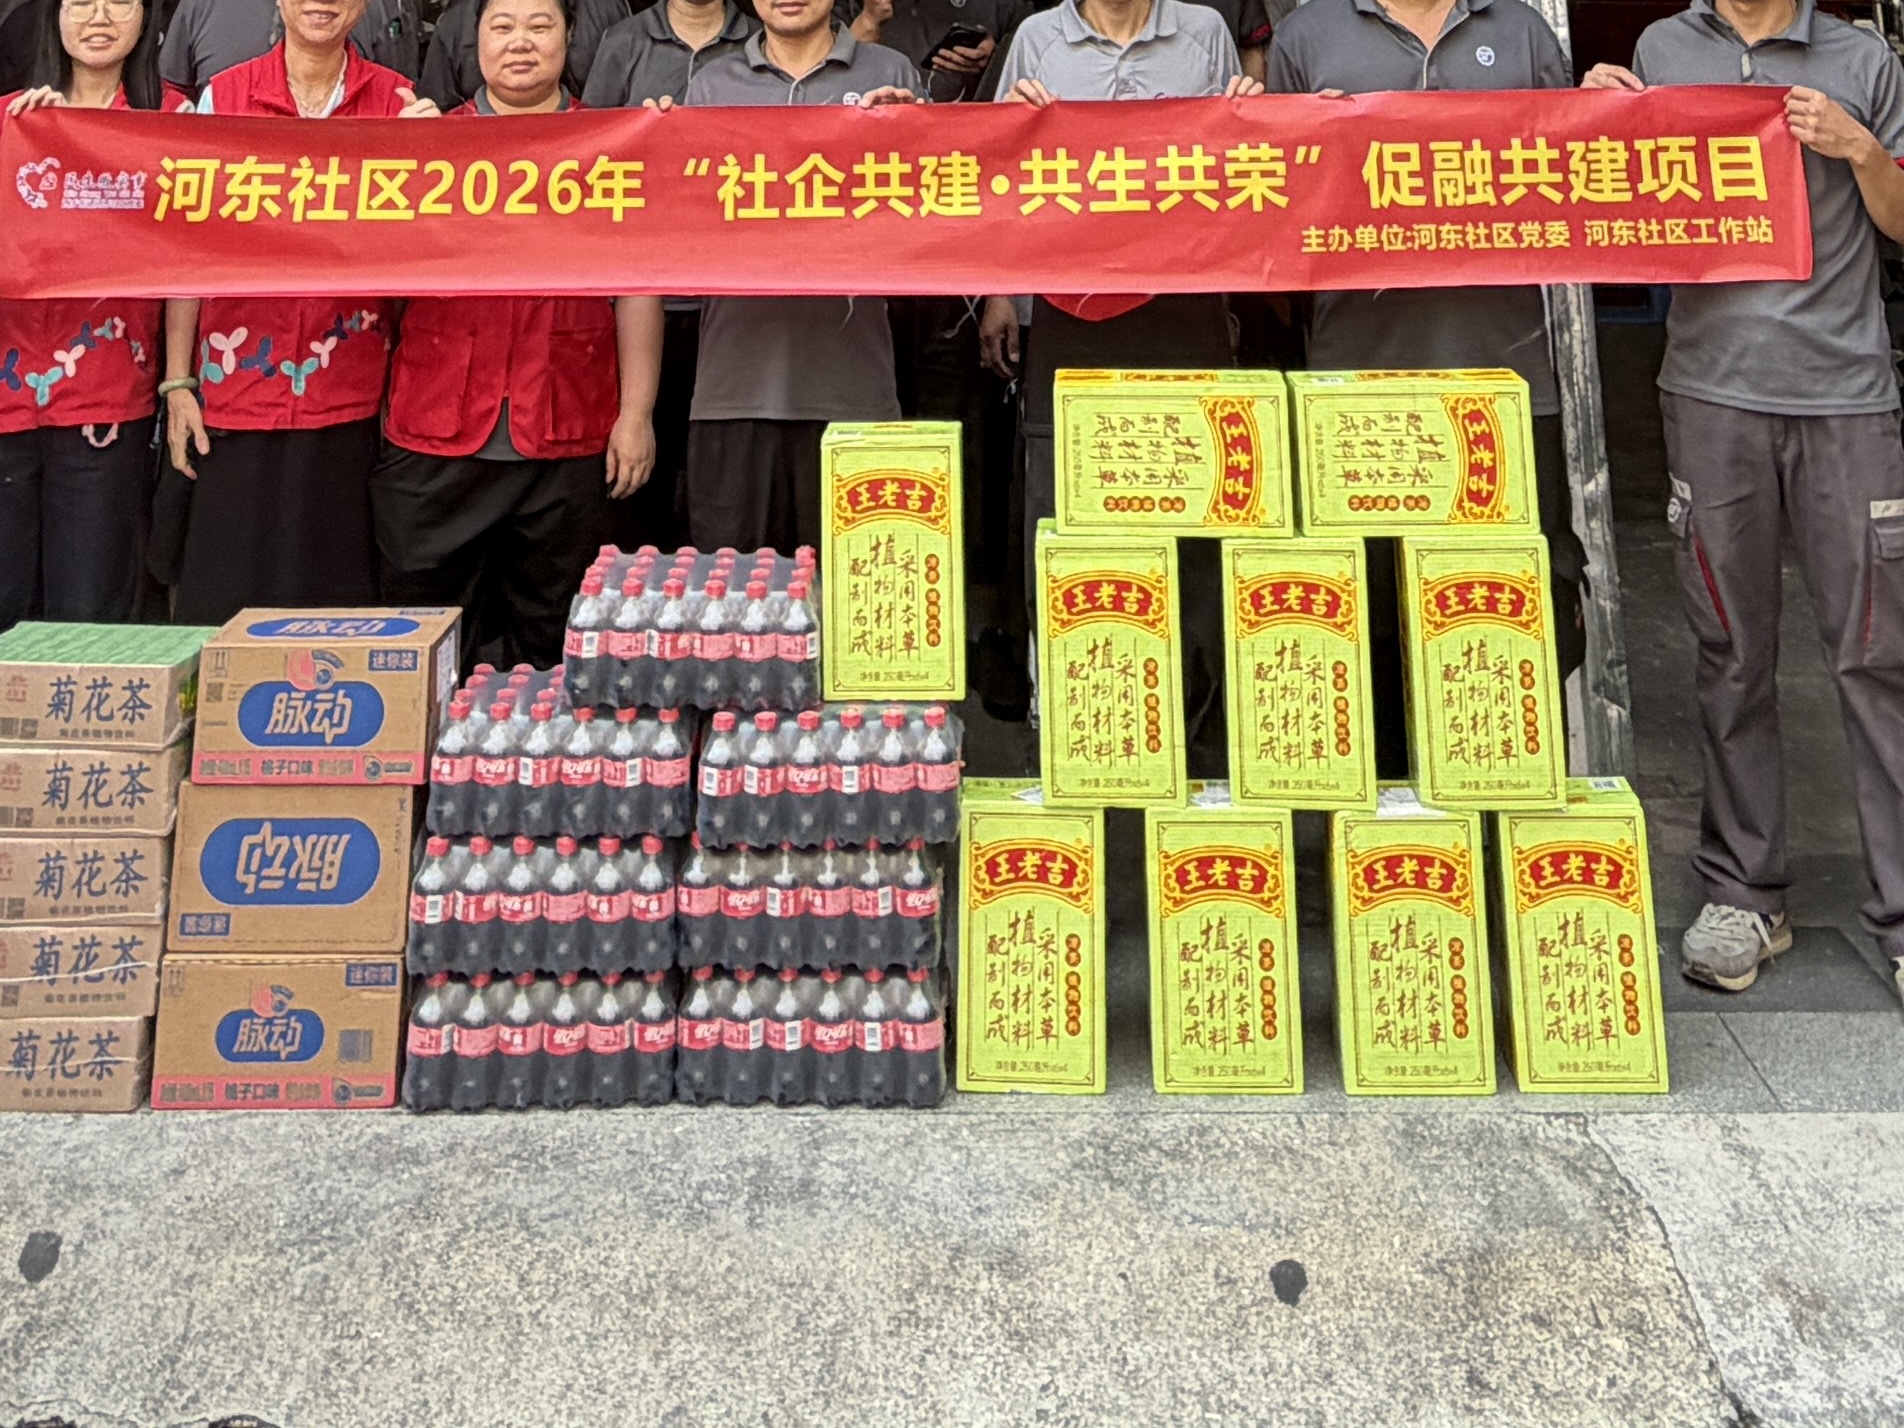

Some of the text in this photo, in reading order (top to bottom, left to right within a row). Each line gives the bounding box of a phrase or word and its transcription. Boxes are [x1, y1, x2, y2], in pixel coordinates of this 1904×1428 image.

[152, 154, 646, 223] 河东社区2026年
[1362, 135, 1770, 211] 促融共建项目
[1583, 217, 1774, 248] 河东社区工作站
[855, 481, 927, 511] 王老吉
[1222, 421, 1252, 500] 王老吉
[1464, 418, 1496, 498] 王老吉
[274, 619, 387, 635] 脉动
[870, 535, 897, 663] 植物材料
[897, 549, 919, 660] 采用本草
[1070, 584, 1144, 614] 王老吉
[1258, 584, 1332, 615] 王老吉
[1444, 583, 1517, 615] 王老吉
[45, 674, 153, 724] 菊花茶
[264, 689, 353, 744] 脉动
[1087, 636, 1115, 770] 植物材料
[1116, 653, 1139, 766] 采用本草
[1275, 639, 1303, 772] 植物材料
[1303, 654, 1328, 764] 采用本草
[1461, 639, 1493, 773] 植物材料
[1491, 654, 1518, 766] 采用本草
[41, 760, 154, 811] 菊花茶
[32, 849, 148, 900] 菊花茶
[235, 821, 351, 894] 脉动
[994, 851, 1069, 885] 王老吉
[1183, 858, 1260, 892] 王老吉
[1372, 856, 1448, 890] 王老吉
[1539, 852, 1615, 887] 王老吉
[30, 934, 146, 986] 菊花茶
[1008, 909, 1036, 1051] 植物材料
[1036, 928, 1059, 1043] 采用本草
[1200, 916, 1229, 1056] 植物材料
[1231, 933, 1255, 1047] 采用本草
[1390, 915, 1420, 1055] 植物材料
[1419, 932, 1446, 1046] 采用本草
[1559, 912, 1591, 1052] 植物材料
[1589, 928, 1618, 1044] 采用本草
[5, 1028, 124, 1082] 菊花茶
[232, 1015, 303, 1061] 脉动
